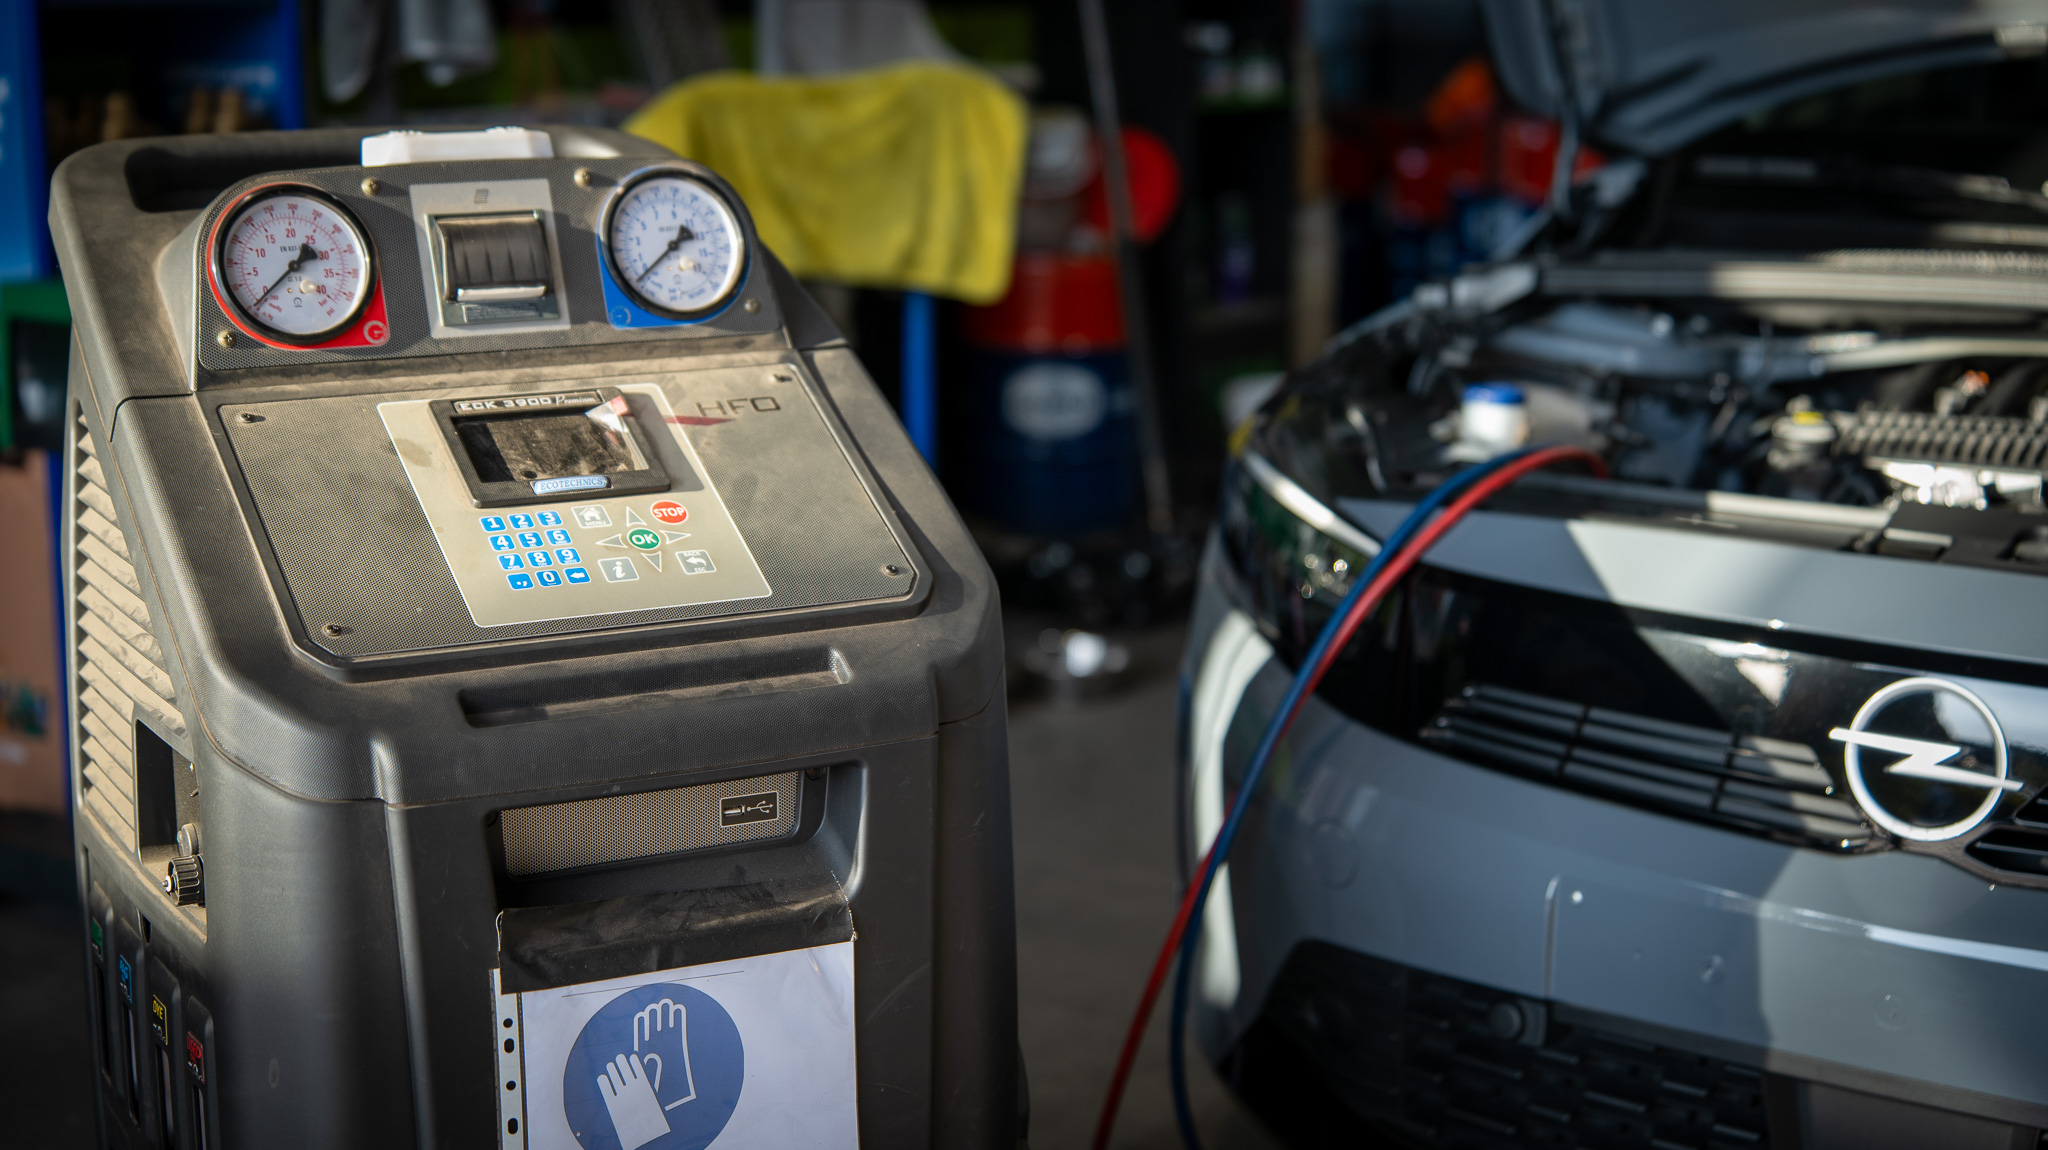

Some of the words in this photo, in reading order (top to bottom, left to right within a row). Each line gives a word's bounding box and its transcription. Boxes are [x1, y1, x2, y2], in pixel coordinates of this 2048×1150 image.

[285, 228, 296, 238] 20
[265, 234, 276, 244] 15
[305, 235, 316, 245] 25
[255, 248, 266, 258] 10
[319, 250, 330, 260] 30
[253, 267, 258, 276] 5
[324, 268, 334, 278] 35
[316, 284, 326, 294] 40
[460, 402, 498, 411] ECK
[502, 396, 552, 408] 3900
[555, 394, 596, 406] Premium
[694, 396, 781, 417] HFO
[540, 477, 604, 490] ECOTECHNICS
[543, 512, 555, 522] 3
[653, 507, 685, 518] STOP
[487, 518, 500, 528] 1
[515, 515, 528, 525] 2
[497, 536, 508, 546] 4
[524, 533, 536, 544] 5
[553, 531, 565, 541] 6
[631, 533, 658, 545] OK
[533, 552, 546, 563] 8
[561, 550, 574, 560] 9
[504, 555, 515, 566] 7
[543, 572, 555, 583] 0
[153, 1000, 164, 1020] DYE
[187, 1036, 202, 1059] USED
